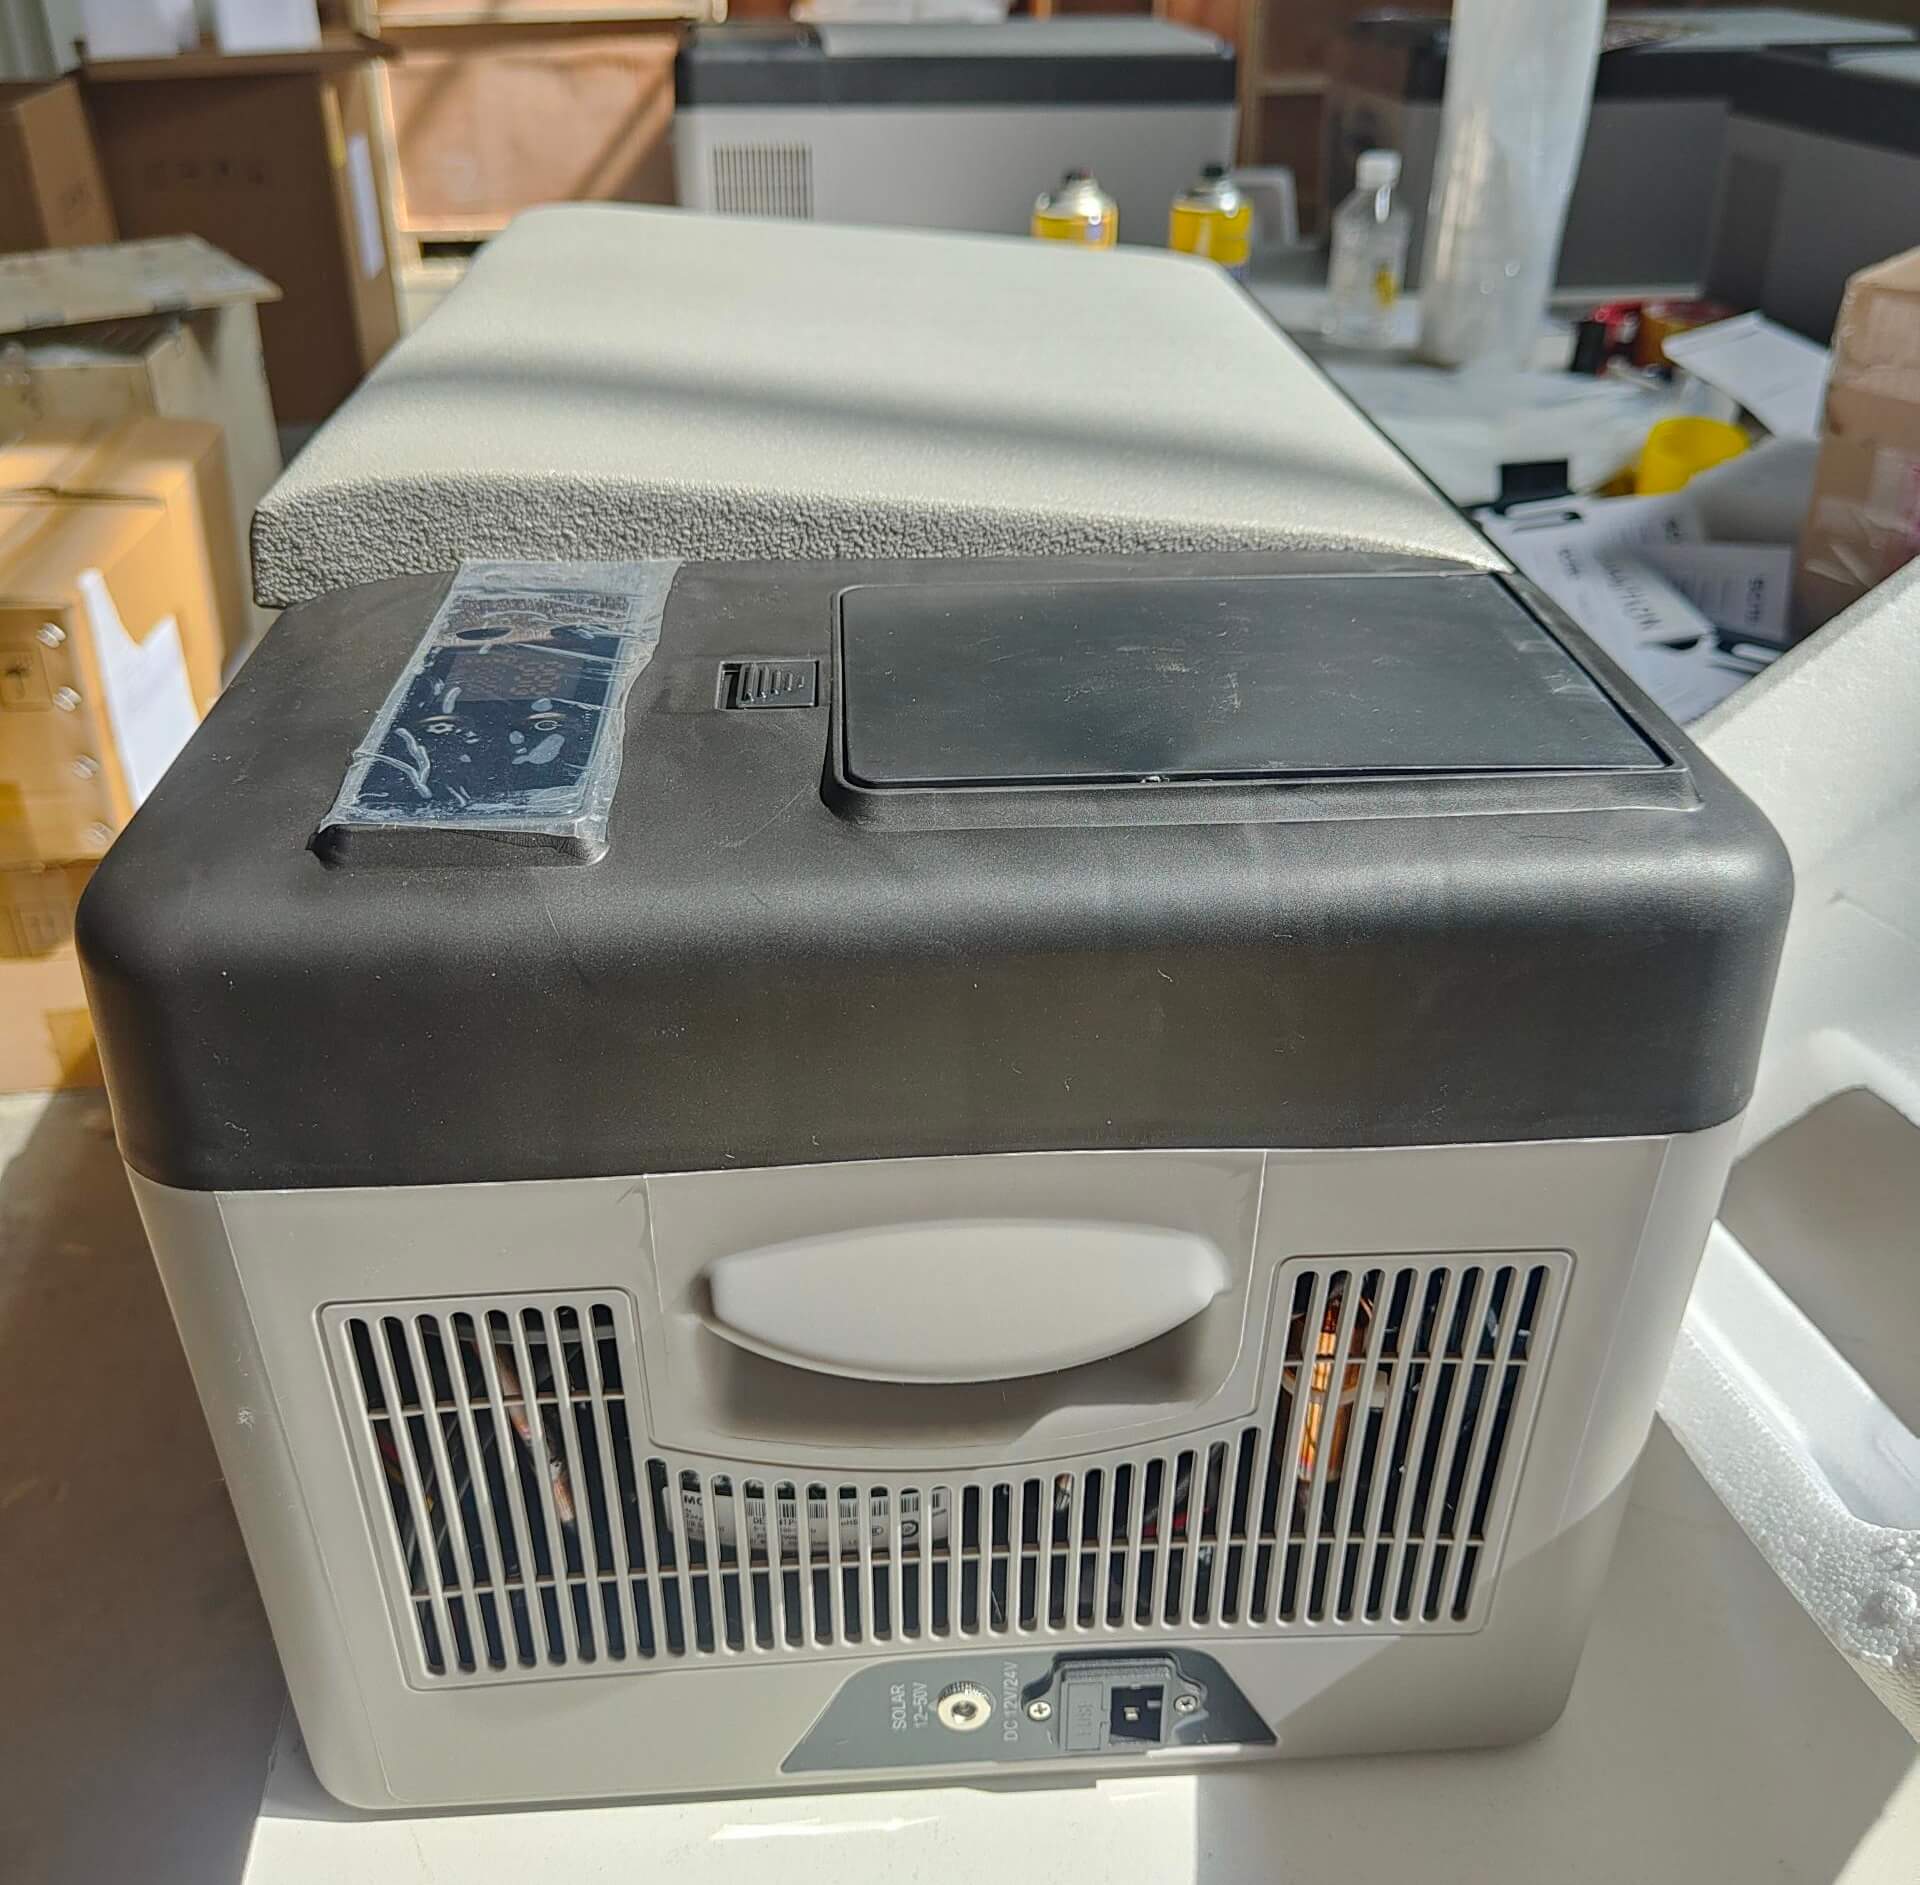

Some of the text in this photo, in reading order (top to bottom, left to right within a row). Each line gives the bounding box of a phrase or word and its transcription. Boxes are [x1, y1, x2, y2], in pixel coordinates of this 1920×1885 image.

[890, 1683, 907, 1729] SOLAR
[912, 1681, 928, 1728] 12-50V
[1003, 1661, 1019, 1741] DC 12V/24V
